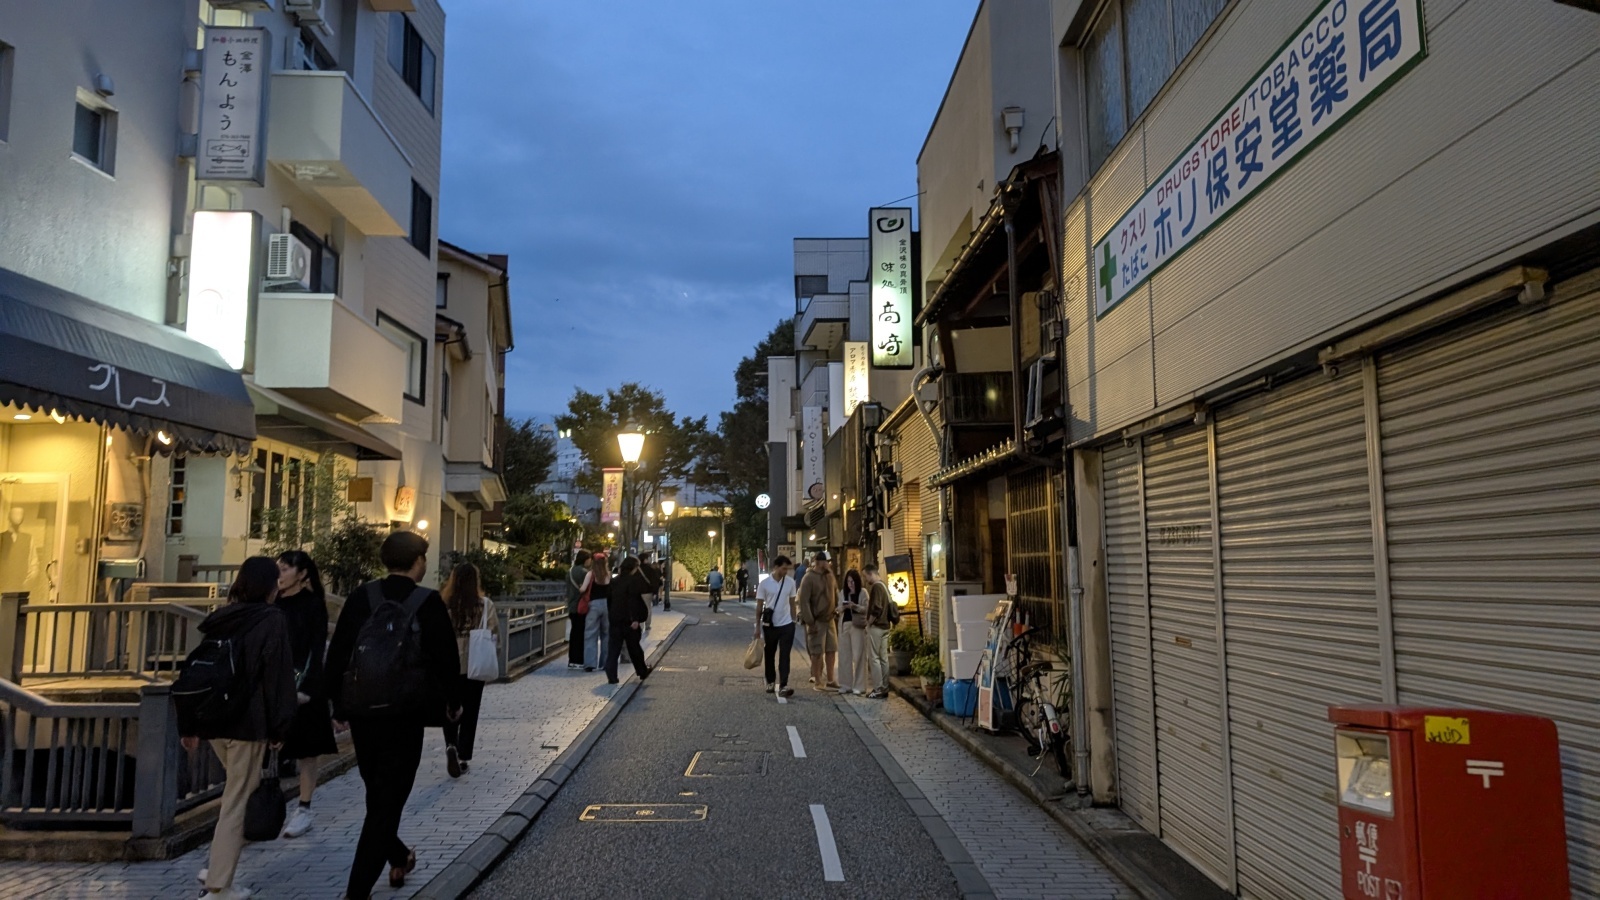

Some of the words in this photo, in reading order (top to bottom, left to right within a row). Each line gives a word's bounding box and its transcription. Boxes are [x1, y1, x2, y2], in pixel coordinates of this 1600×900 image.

[218, 49, 238, 131] もんよう
[1120, 207, 1147, 255] クスリ
[898, 238, 908, 295] 金沢味の真骨頂
[1121, 243, 1149, 289] たばこ
[87, 363, 171, 409] グレース
[1357, 870, 1381, 898] POST
